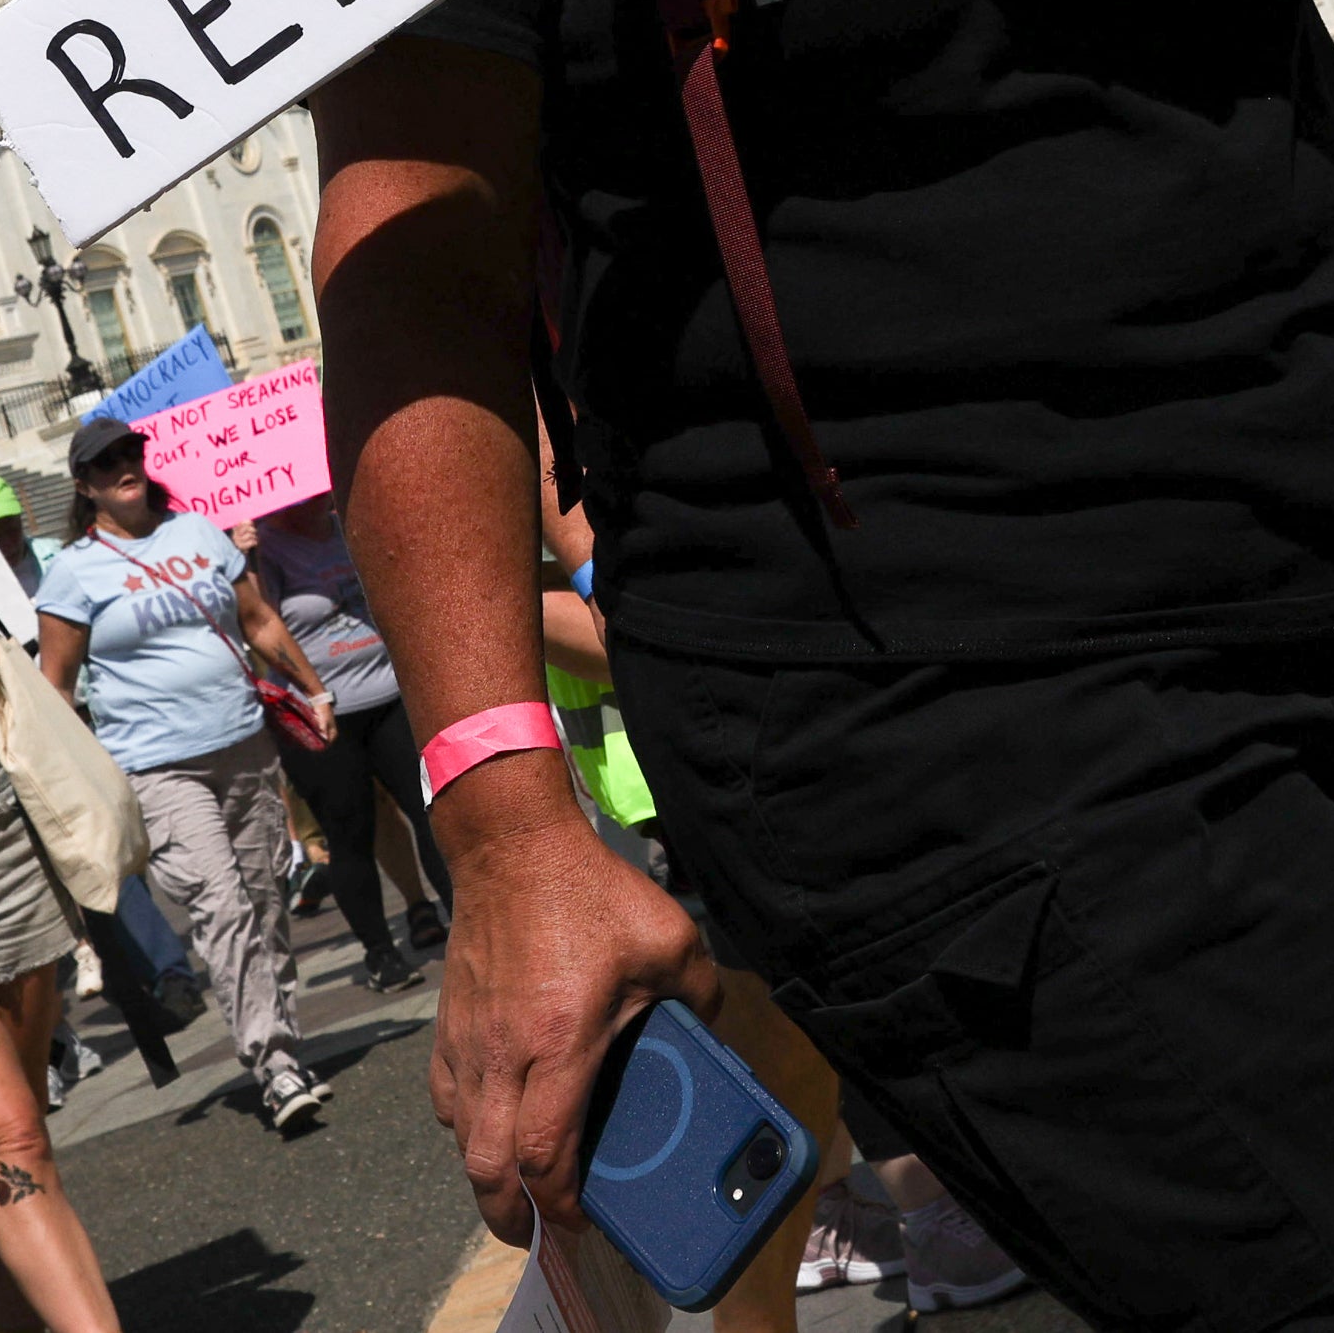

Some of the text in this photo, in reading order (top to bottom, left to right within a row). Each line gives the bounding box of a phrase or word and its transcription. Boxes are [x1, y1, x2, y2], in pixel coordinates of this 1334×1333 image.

[170, 400, 212, 435] NOT
[227, 366, 315, 410] SPEAKING
[153, 404, 298, 470] OUT, WE LOSE
[214, 450, 257, 478] OUR
[190, 462, 296, 516] DIGNITY
[143, 555, 193, 588] NO
[132, 570, 235, 638] KINGS
